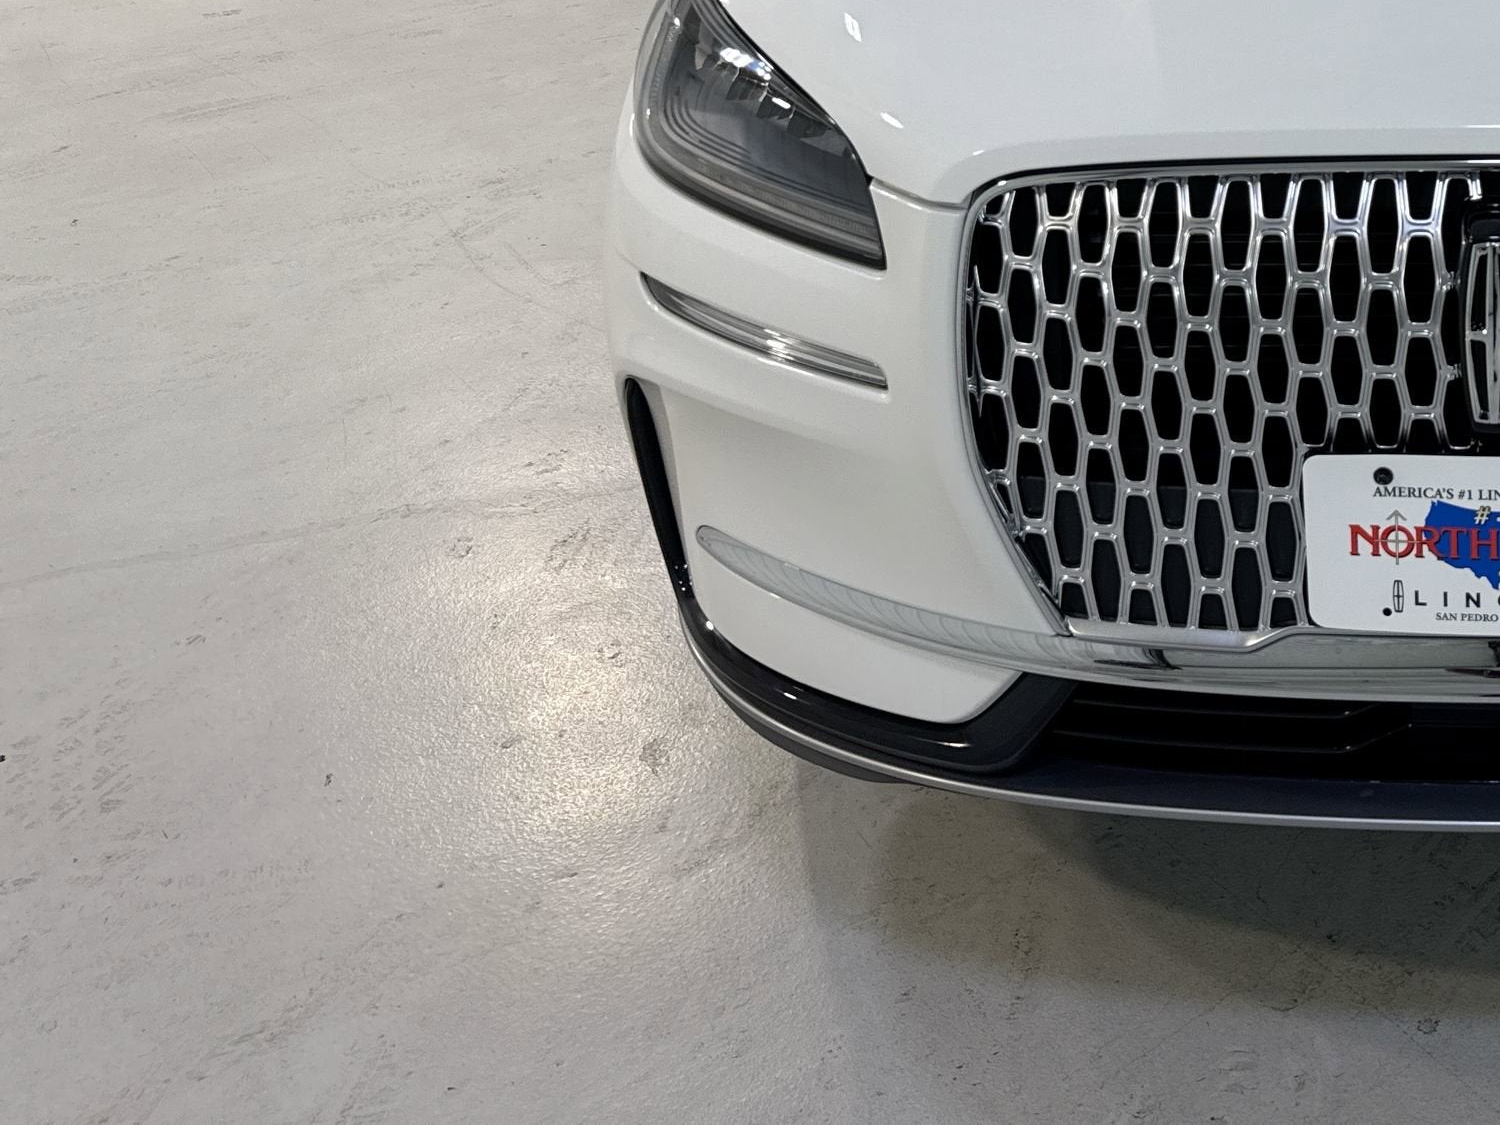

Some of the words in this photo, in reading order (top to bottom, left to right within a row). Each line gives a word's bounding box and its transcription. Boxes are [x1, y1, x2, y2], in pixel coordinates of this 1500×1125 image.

[1373, 486, 1455, 500] AMERICA'S
[1458, 488, 1475, 500] #1
[1348, 524, 1500, 561] NORTH
[1435, 612, 1458, 622] SAN
[1460, 613, 1499, 623] PEDRO
